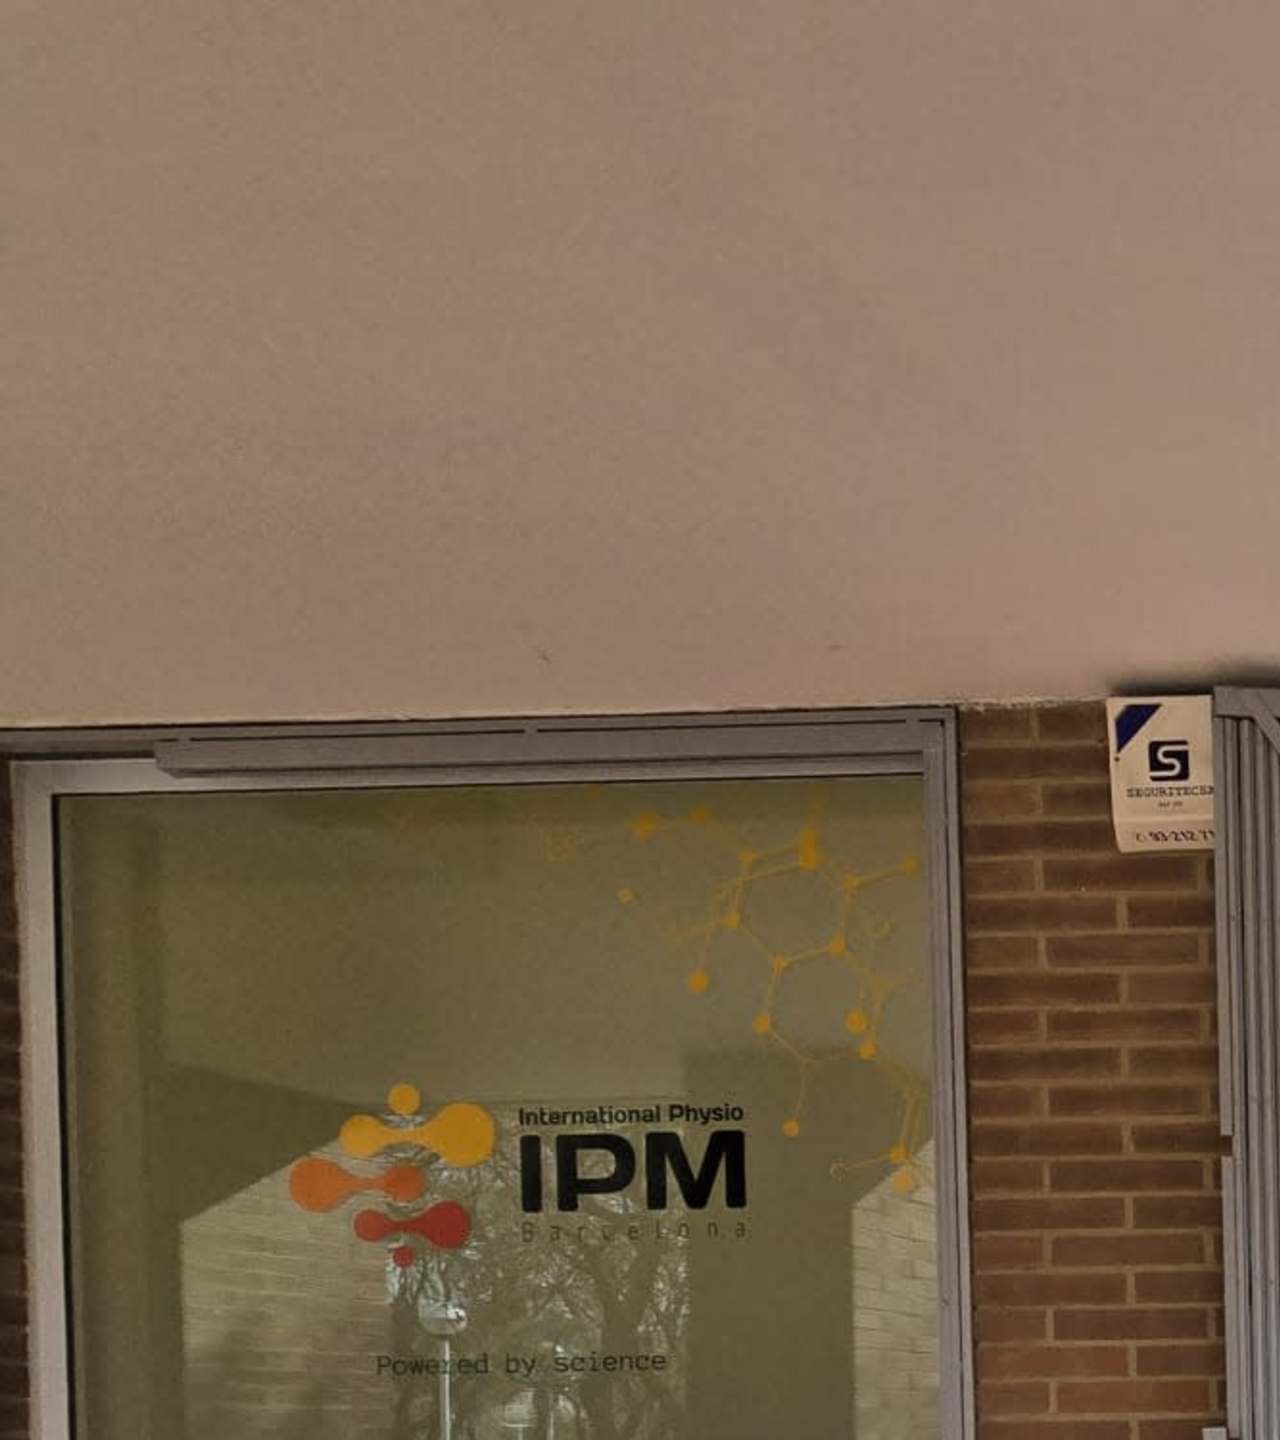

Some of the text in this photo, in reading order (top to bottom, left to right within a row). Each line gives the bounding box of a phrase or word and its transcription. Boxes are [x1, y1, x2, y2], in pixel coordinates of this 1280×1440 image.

[519, 1103, 744, 1126] International Physio
[520, 1130, 747, 1213] IPM
[522, 1219, 747, 1243] Barcelona
[376, 1351, 667, 1378] Powered by science
